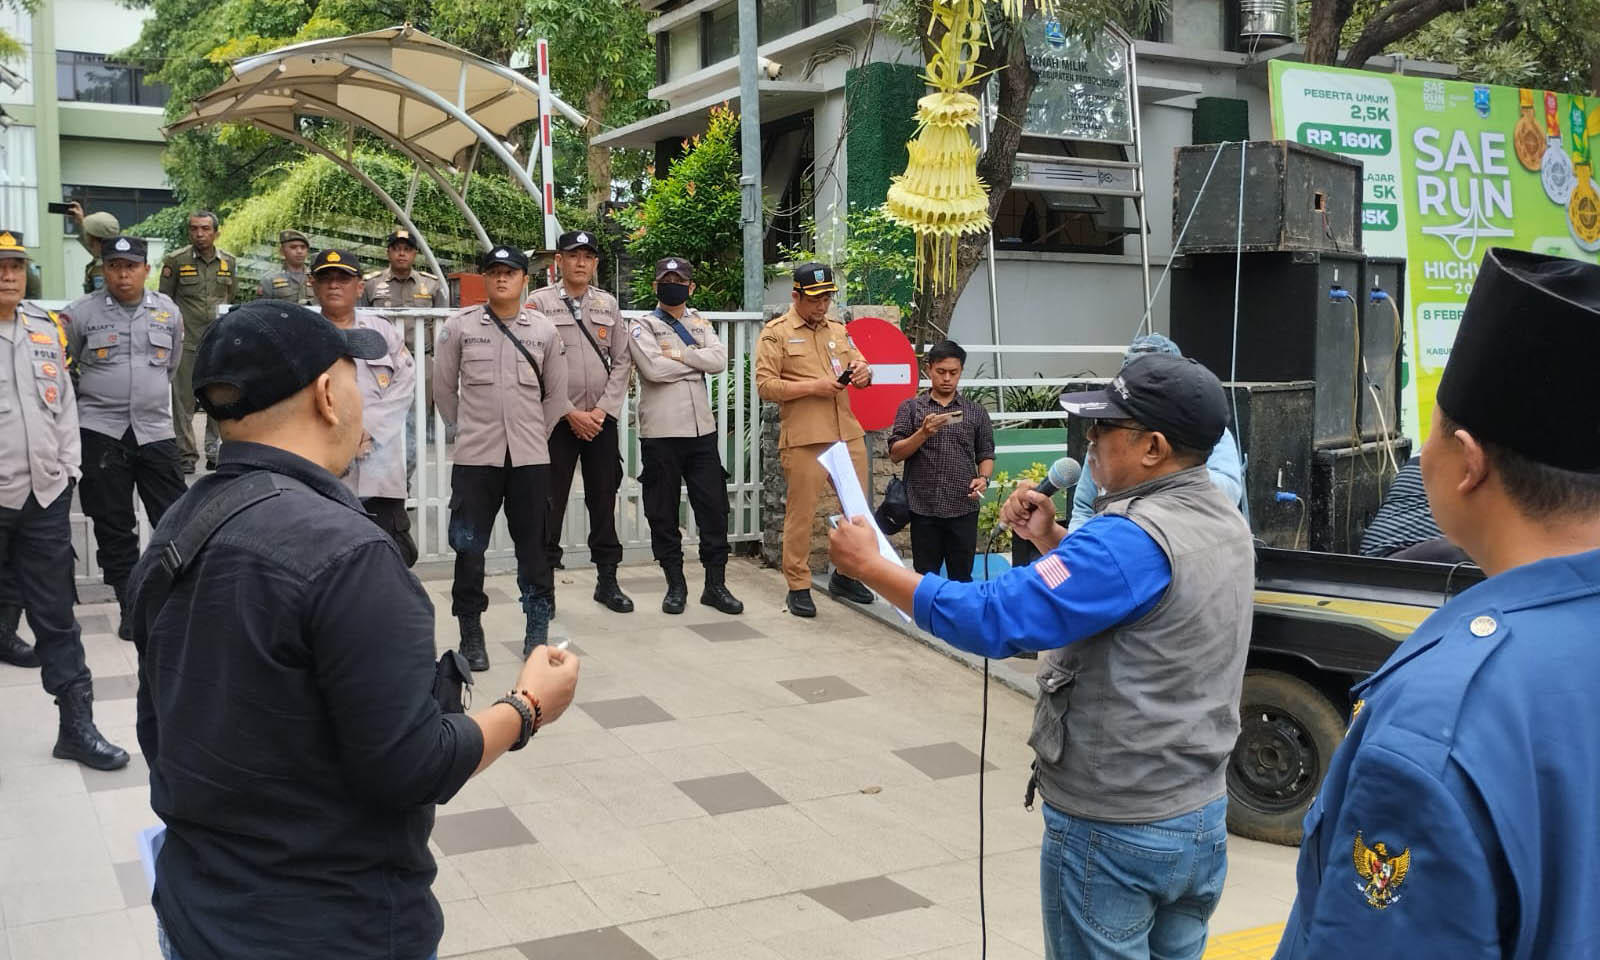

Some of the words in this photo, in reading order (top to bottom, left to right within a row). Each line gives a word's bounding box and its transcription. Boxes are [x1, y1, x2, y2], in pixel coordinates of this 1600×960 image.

[1061, 59, 1088, 73] MILIK
[1304, 88, 1353, 101] PESERTA
[1356, 93, 1389, 104] UMUM
[1351, 105, 1390, 122] 2,5K
[1306, 128, 1337, 146] RP.
[1339, 131, 1384, 149] 160K
[1413, 126, 1509, 175] SAE
[1373, 185, 1396, 199] 5K
[1417, 175, 1513, 219] RUN
[1423, 310, 1431, 320] 8
